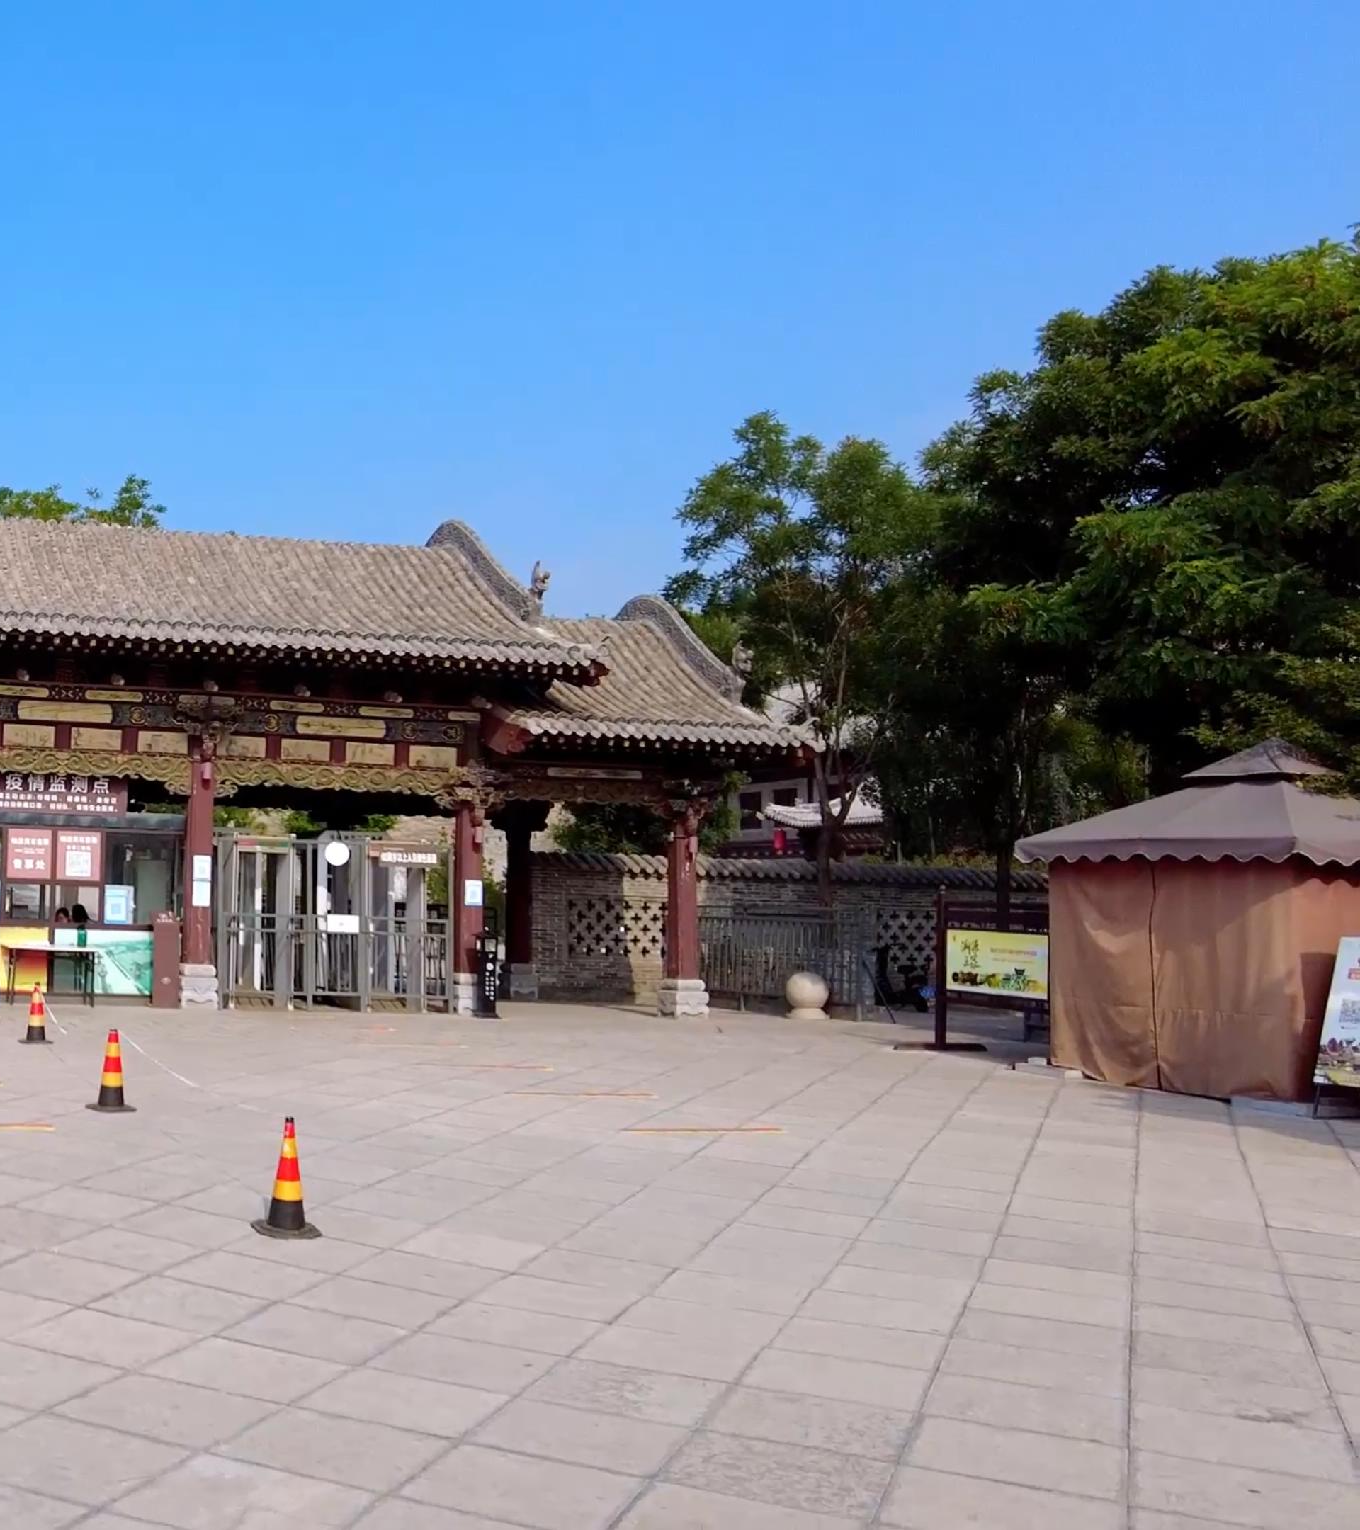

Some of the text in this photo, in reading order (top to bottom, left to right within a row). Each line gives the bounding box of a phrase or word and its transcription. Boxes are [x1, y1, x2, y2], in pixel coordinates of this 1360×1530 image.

[5, 774, 109, 794] 疫情监测点
